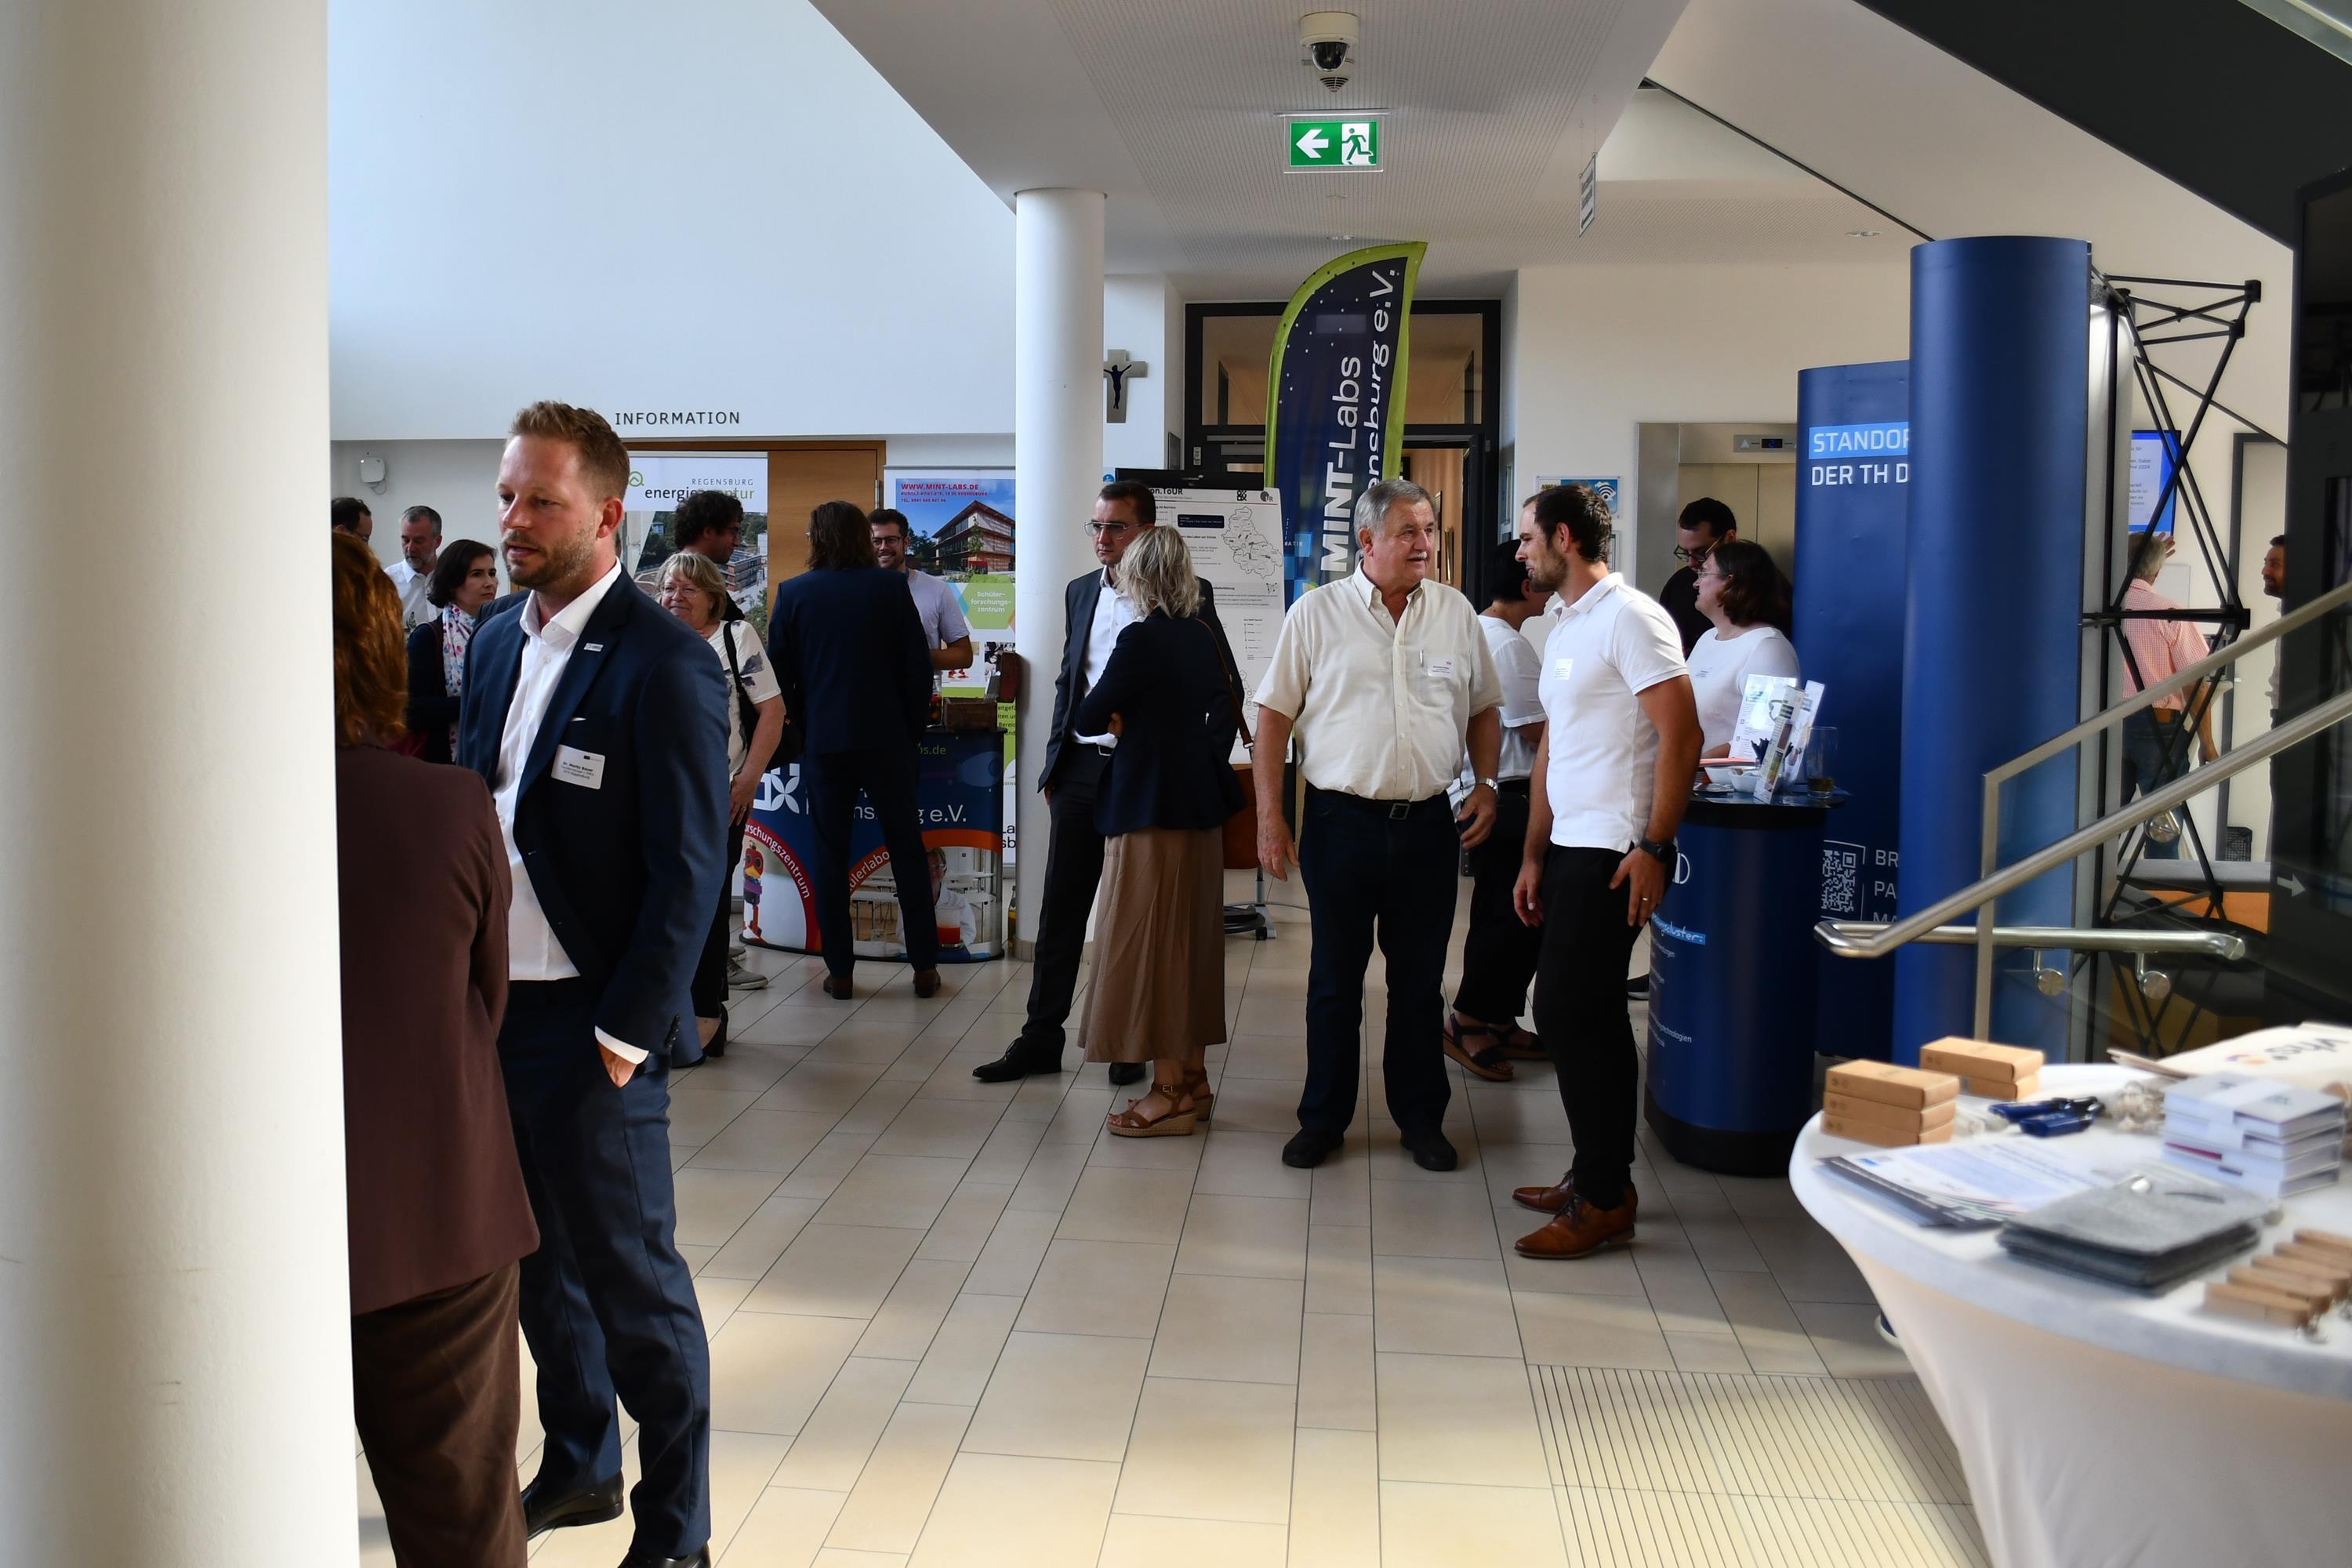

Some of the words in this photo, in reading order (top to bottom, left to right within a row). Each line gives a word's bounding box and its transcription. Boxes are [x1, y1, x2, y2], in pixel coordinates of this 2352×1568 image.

[1369, 269, 1396, 332] e.V.
[615, 412, 740, 426] INFORMATION
[1320, 356, 1361, 572] MINT-Labs
[1811, 465, 1853, 486] DER
[1859, 463, 1888, 485] TH
[971, 598, 1011, 607] forschungs-
[930, 804, 967, 822] e.V.
[1875, 849, 1899, 868] BR
[1874, 880, 1897, 900] PA
